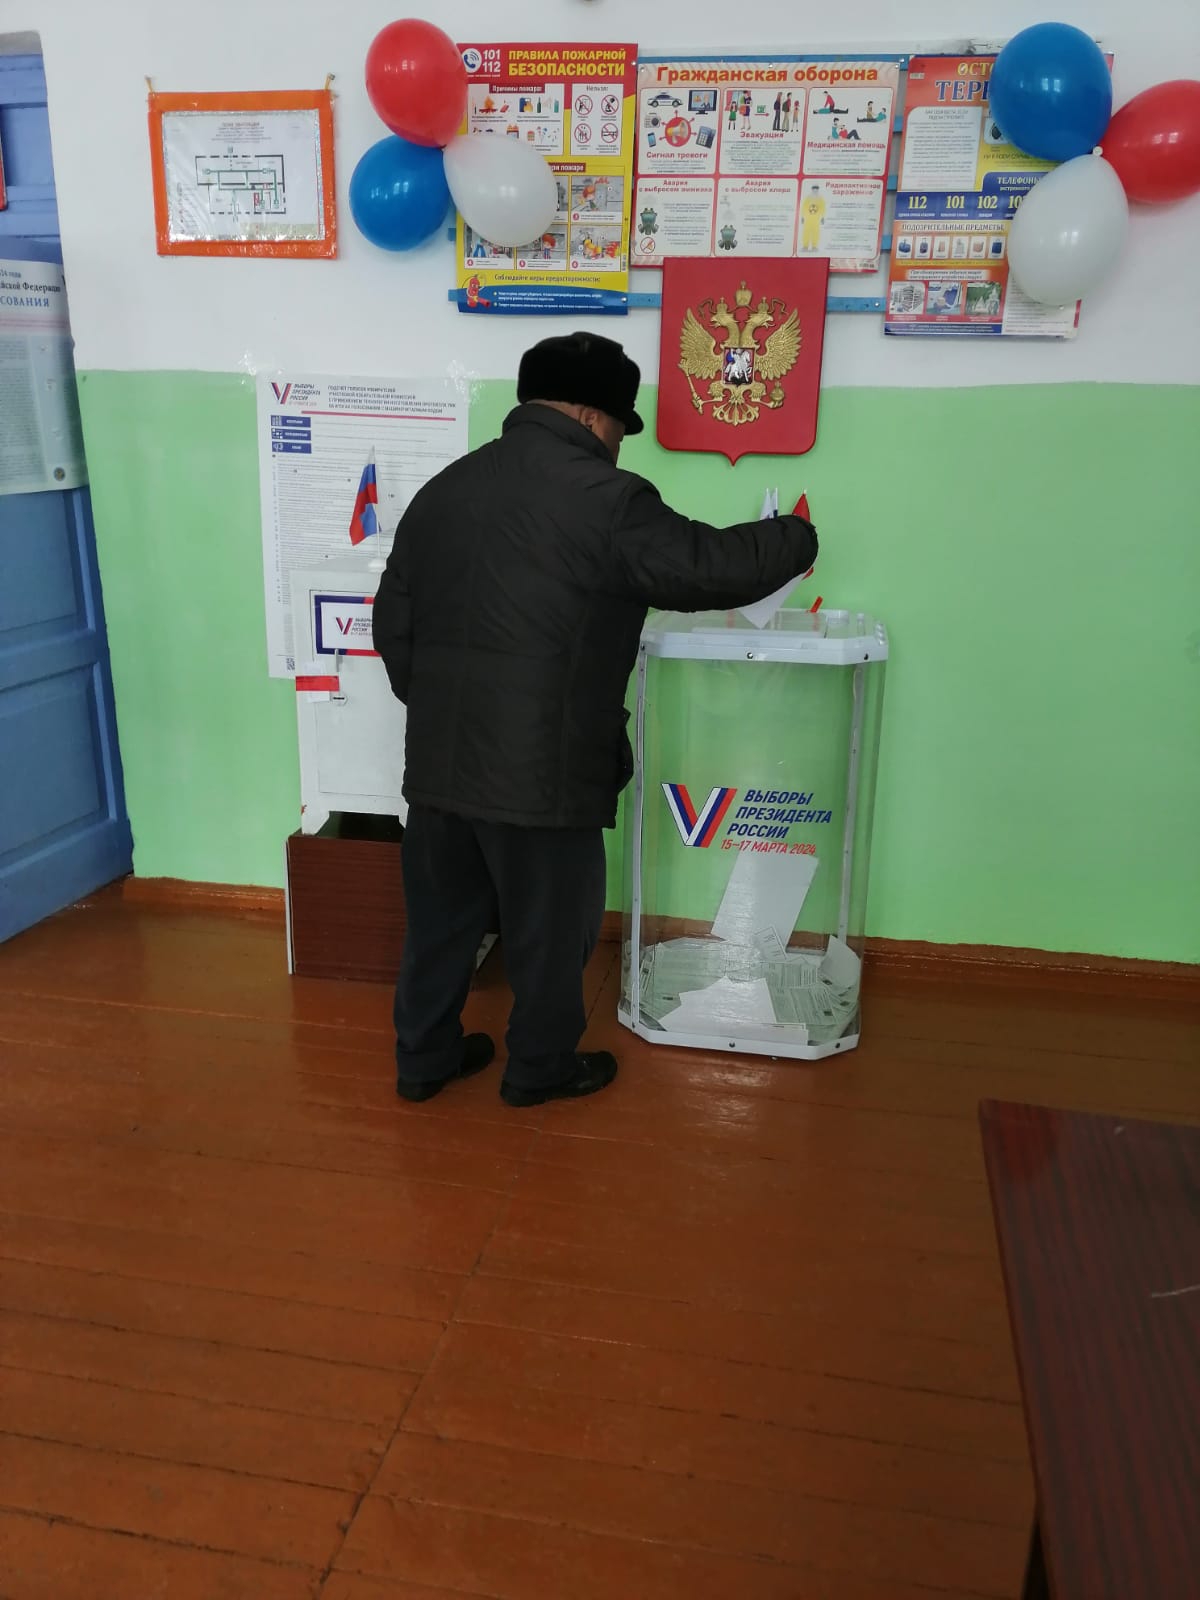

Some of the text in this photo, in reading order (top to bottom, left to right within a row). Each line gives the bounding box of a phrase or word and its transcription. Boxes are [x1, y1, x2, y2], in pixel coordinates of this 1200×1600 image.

[483, 50, 500, 60] 101
[508, 48, 626, 60] ПРАВИЛА ПОЖАРНОЙ
[482, 61, 501, 73] 112
[508, 62, 626, 76] БЕЗОПАСНОСТИ
[656, 66, 878, 85] Гражданская оборона
[740, 131, 784, 140] Эвакуация
[807, 140, 886, 150] Медицинская помощь
[908, 196, 927, 209] 112
[946, 196, 965, 209] 101
[977, 195, 998, 209] 102
[1008, 195, 1023, 209] 10
[744, 790, 814, 806] ВЫБОРЫ
[736, 806, 832, 824] ПРЕЗИДЕНТА
[726, 823, 790, 838] РОССИИ
[750, 841, 788, 854] МАРТА
[789, 843, 816, 856] 2024
